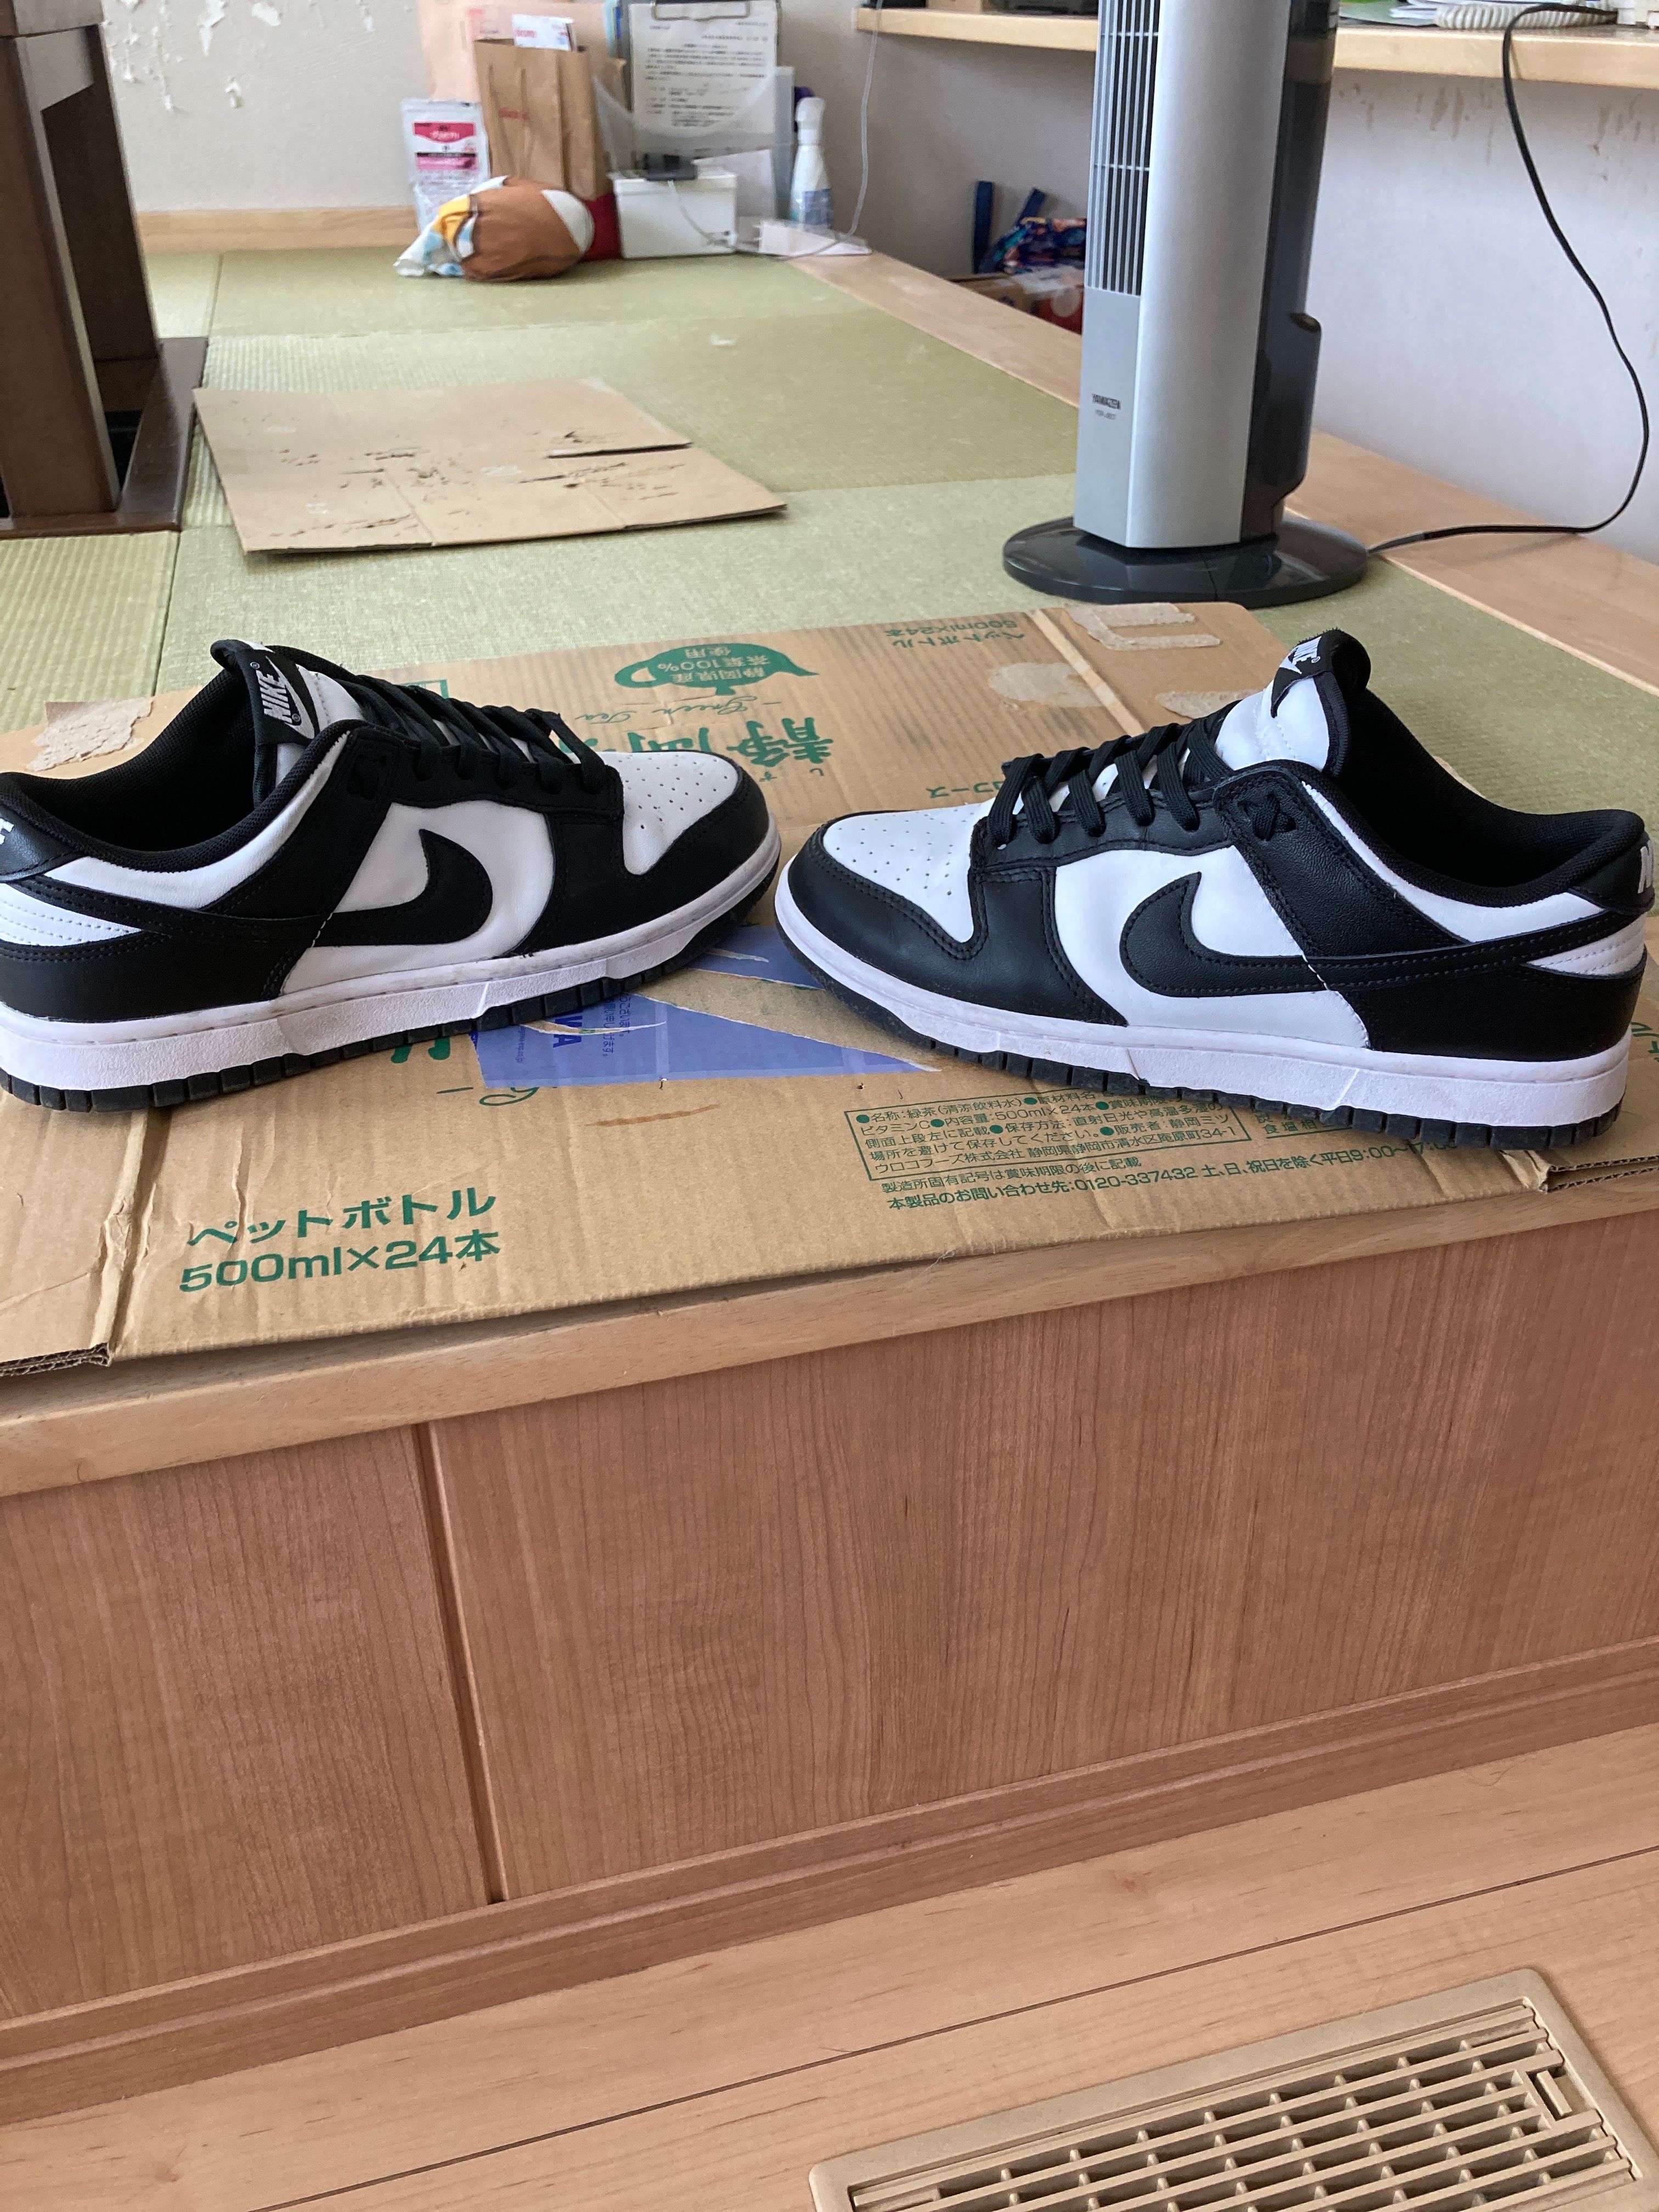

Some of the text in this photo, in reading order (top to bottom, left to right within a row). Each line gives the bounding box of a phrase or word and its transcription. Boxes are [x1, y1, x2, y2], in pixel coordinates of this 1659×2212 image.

[256, 669, 293, 724] NIKE
[188, 1187, 496, 1246] ペットボトル
